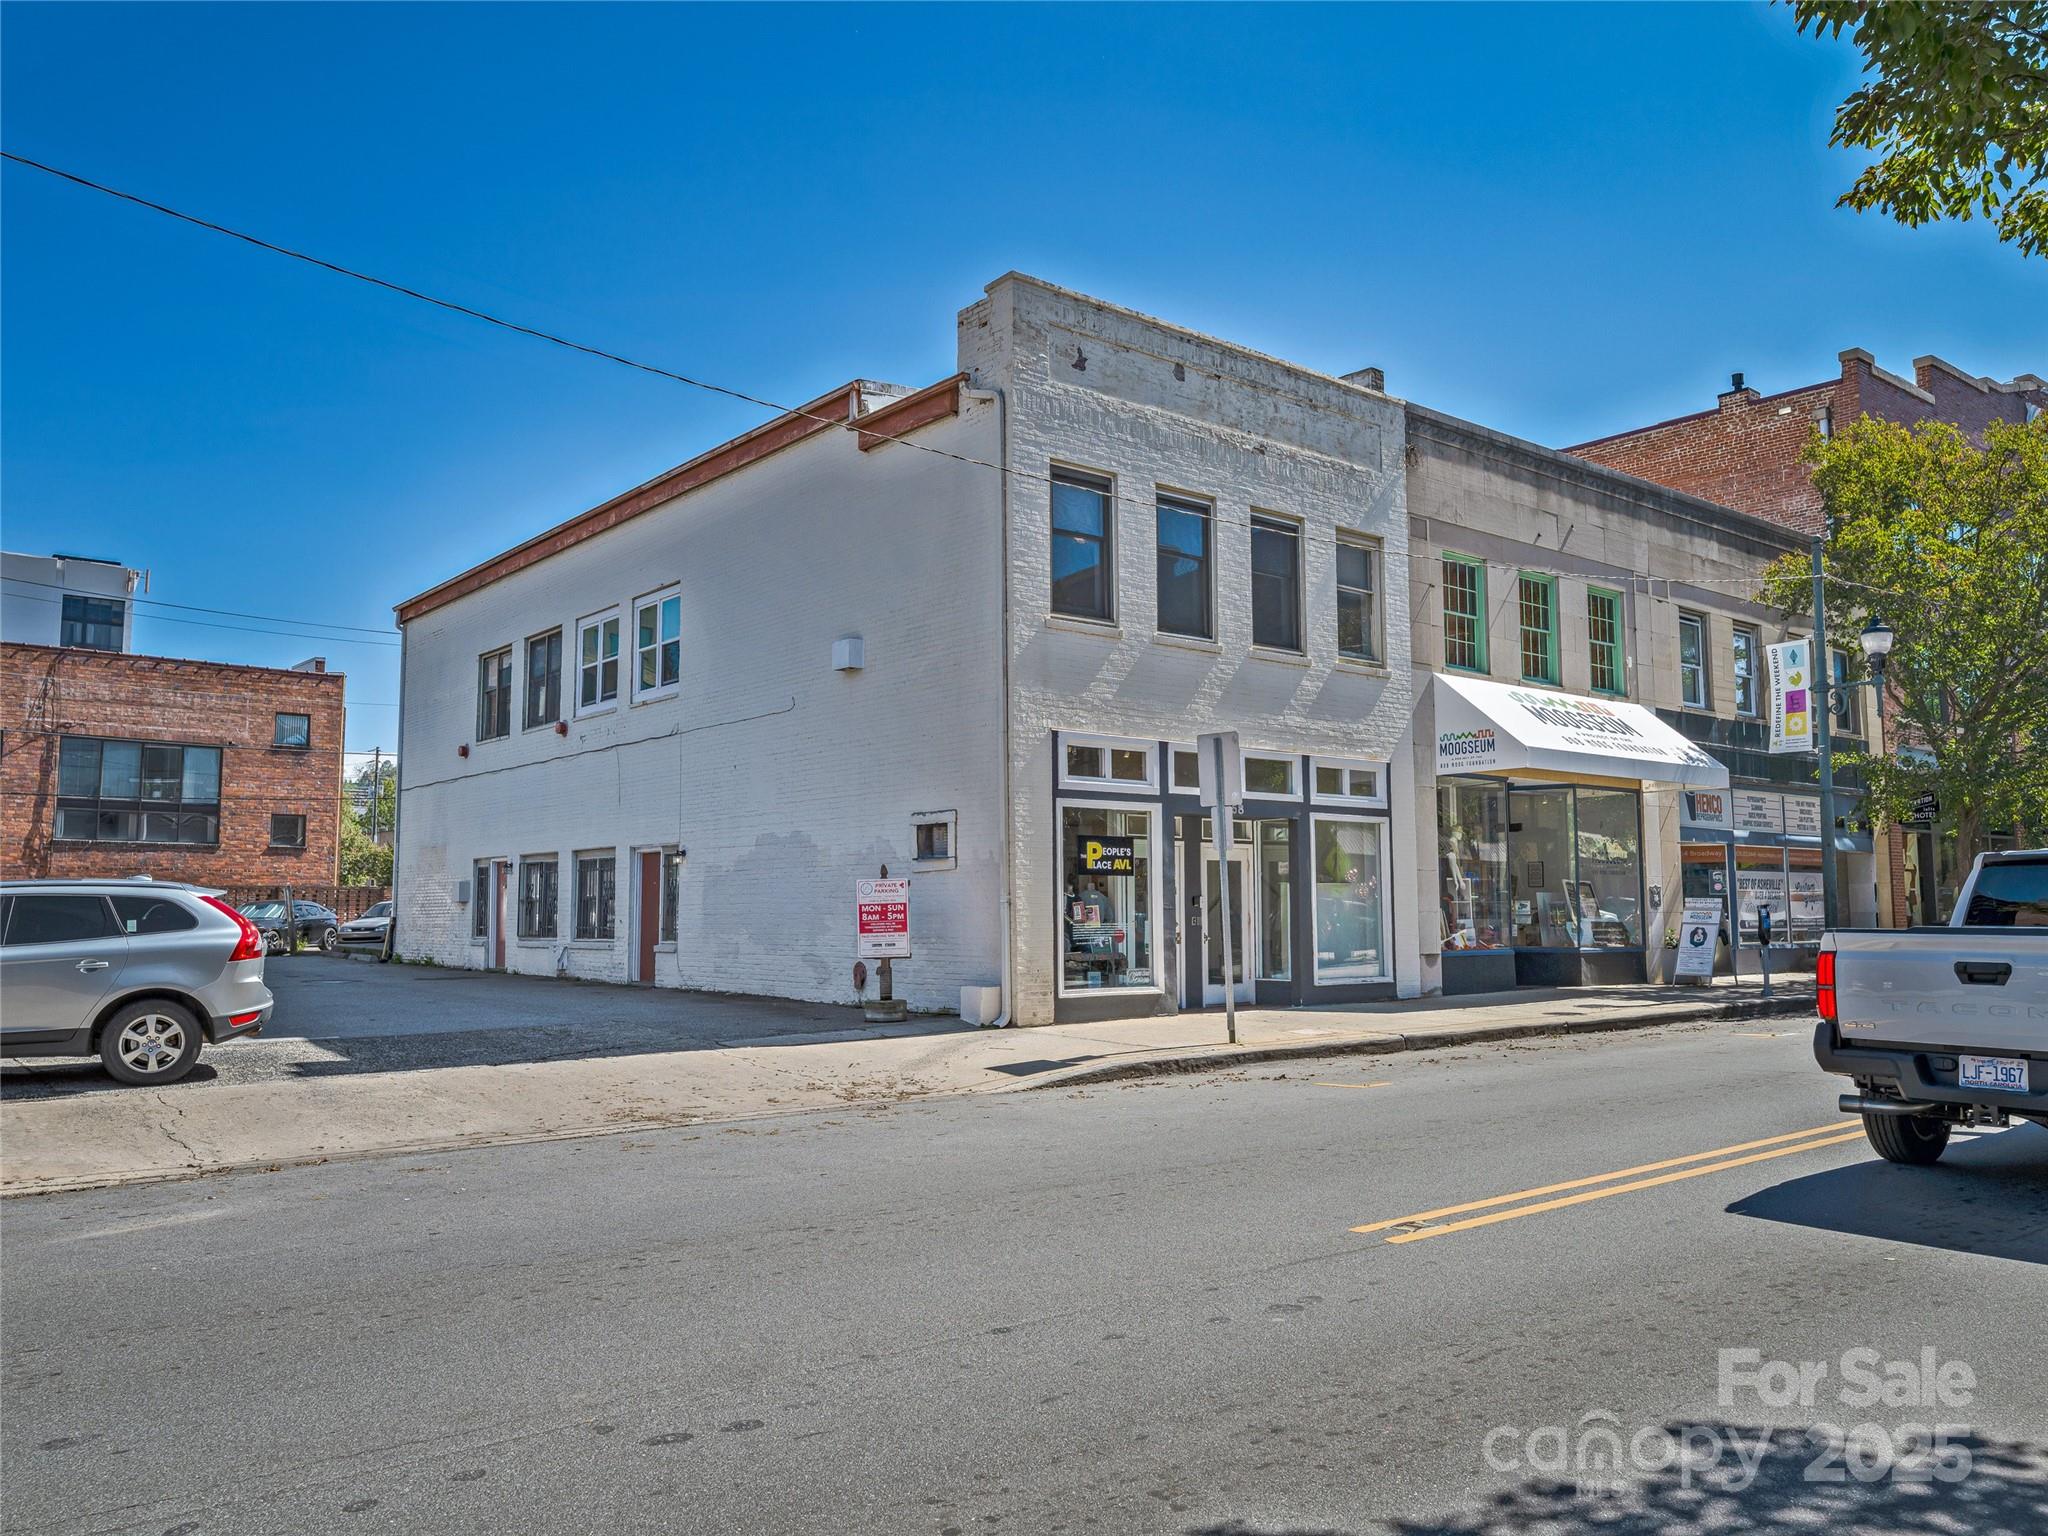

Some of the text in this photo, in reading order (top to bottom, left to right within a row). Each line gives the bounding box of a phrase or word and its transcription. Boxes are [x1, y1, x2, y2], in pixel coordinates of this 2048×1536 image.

[1771, 648, 1782, 686] WEEKEND
[1521, 704, 1644, 738] MOOGSEUM
[1774, 702, 1782, 738] REDEFINE
[1440, 738, 1495, 757] MOOGSEUM
[1696, 793, 1722, 814] HENCO
[1113, 859, 1132, 870] AVL
[1963, 1063, 2024, 1083] LJF-1967
